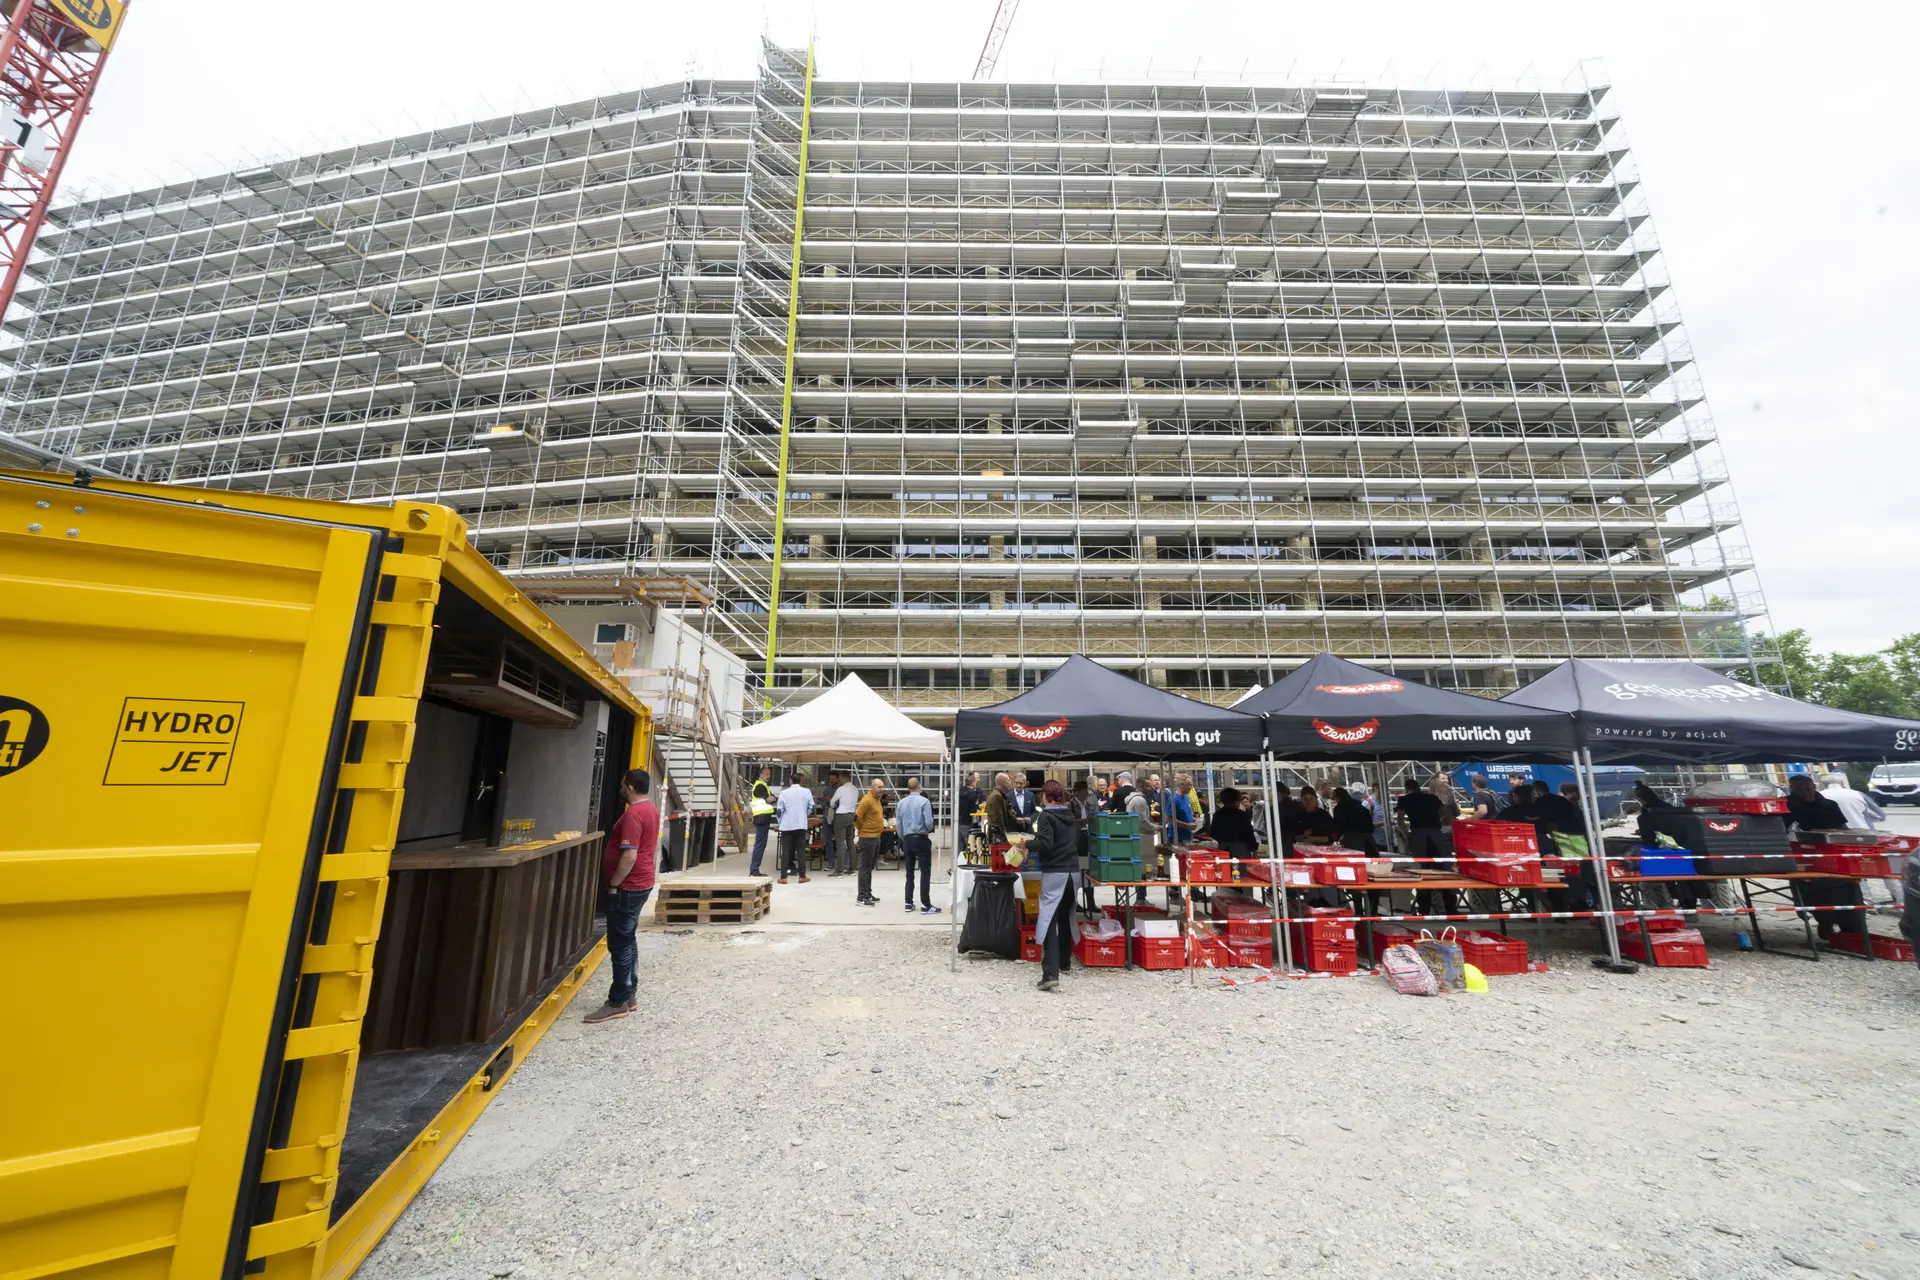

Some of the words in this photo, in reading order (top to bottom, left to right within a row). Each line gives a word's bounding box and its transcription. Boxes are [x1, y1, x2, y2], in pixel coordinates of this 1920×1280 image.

[124, 711, 234, 734] HYDRO
[1009, 723, 1062, 740] Jenzer
[1121, 727, 1190, 742] natürlich
[1195, 730, 1221, 746] gut
[1320, 725, 1374, 741] Jenzer
[1432, 726, 1501, 741] natürlich
[1506, 727, 1531, 744] gut
[1596, 727, 1652, 737] powered
[1662, 729, 1676, 739] by
[1686, 731, 1726, 740] acj.ch
[1894, 729, 1920, 750] ge
[159, 751, 227, 772] JET
